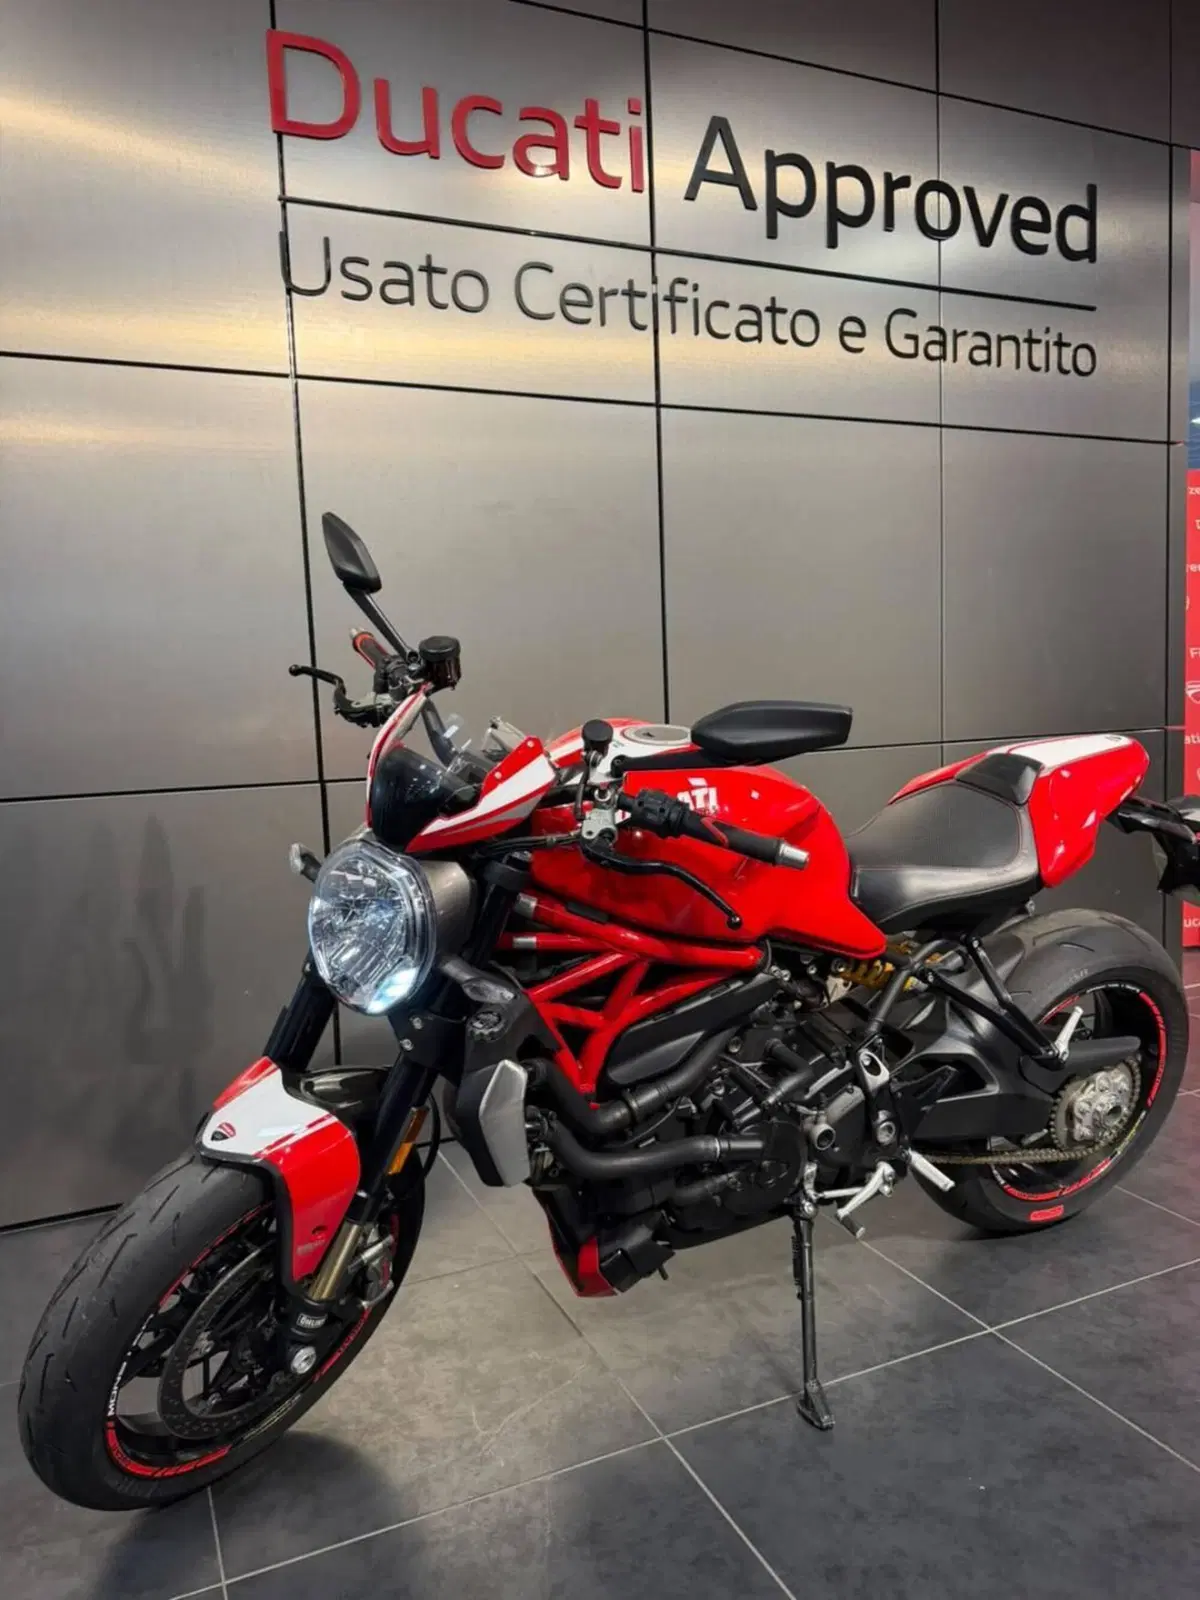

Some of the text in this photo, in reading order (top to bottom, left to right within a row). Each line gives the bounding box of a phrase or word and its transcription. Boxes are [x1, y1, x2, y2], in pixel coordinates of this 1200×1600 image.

[266, 29, 1097, 263] Ducati Approved
[279, 231, 1097, 377] Usato Certificato e Garantito
